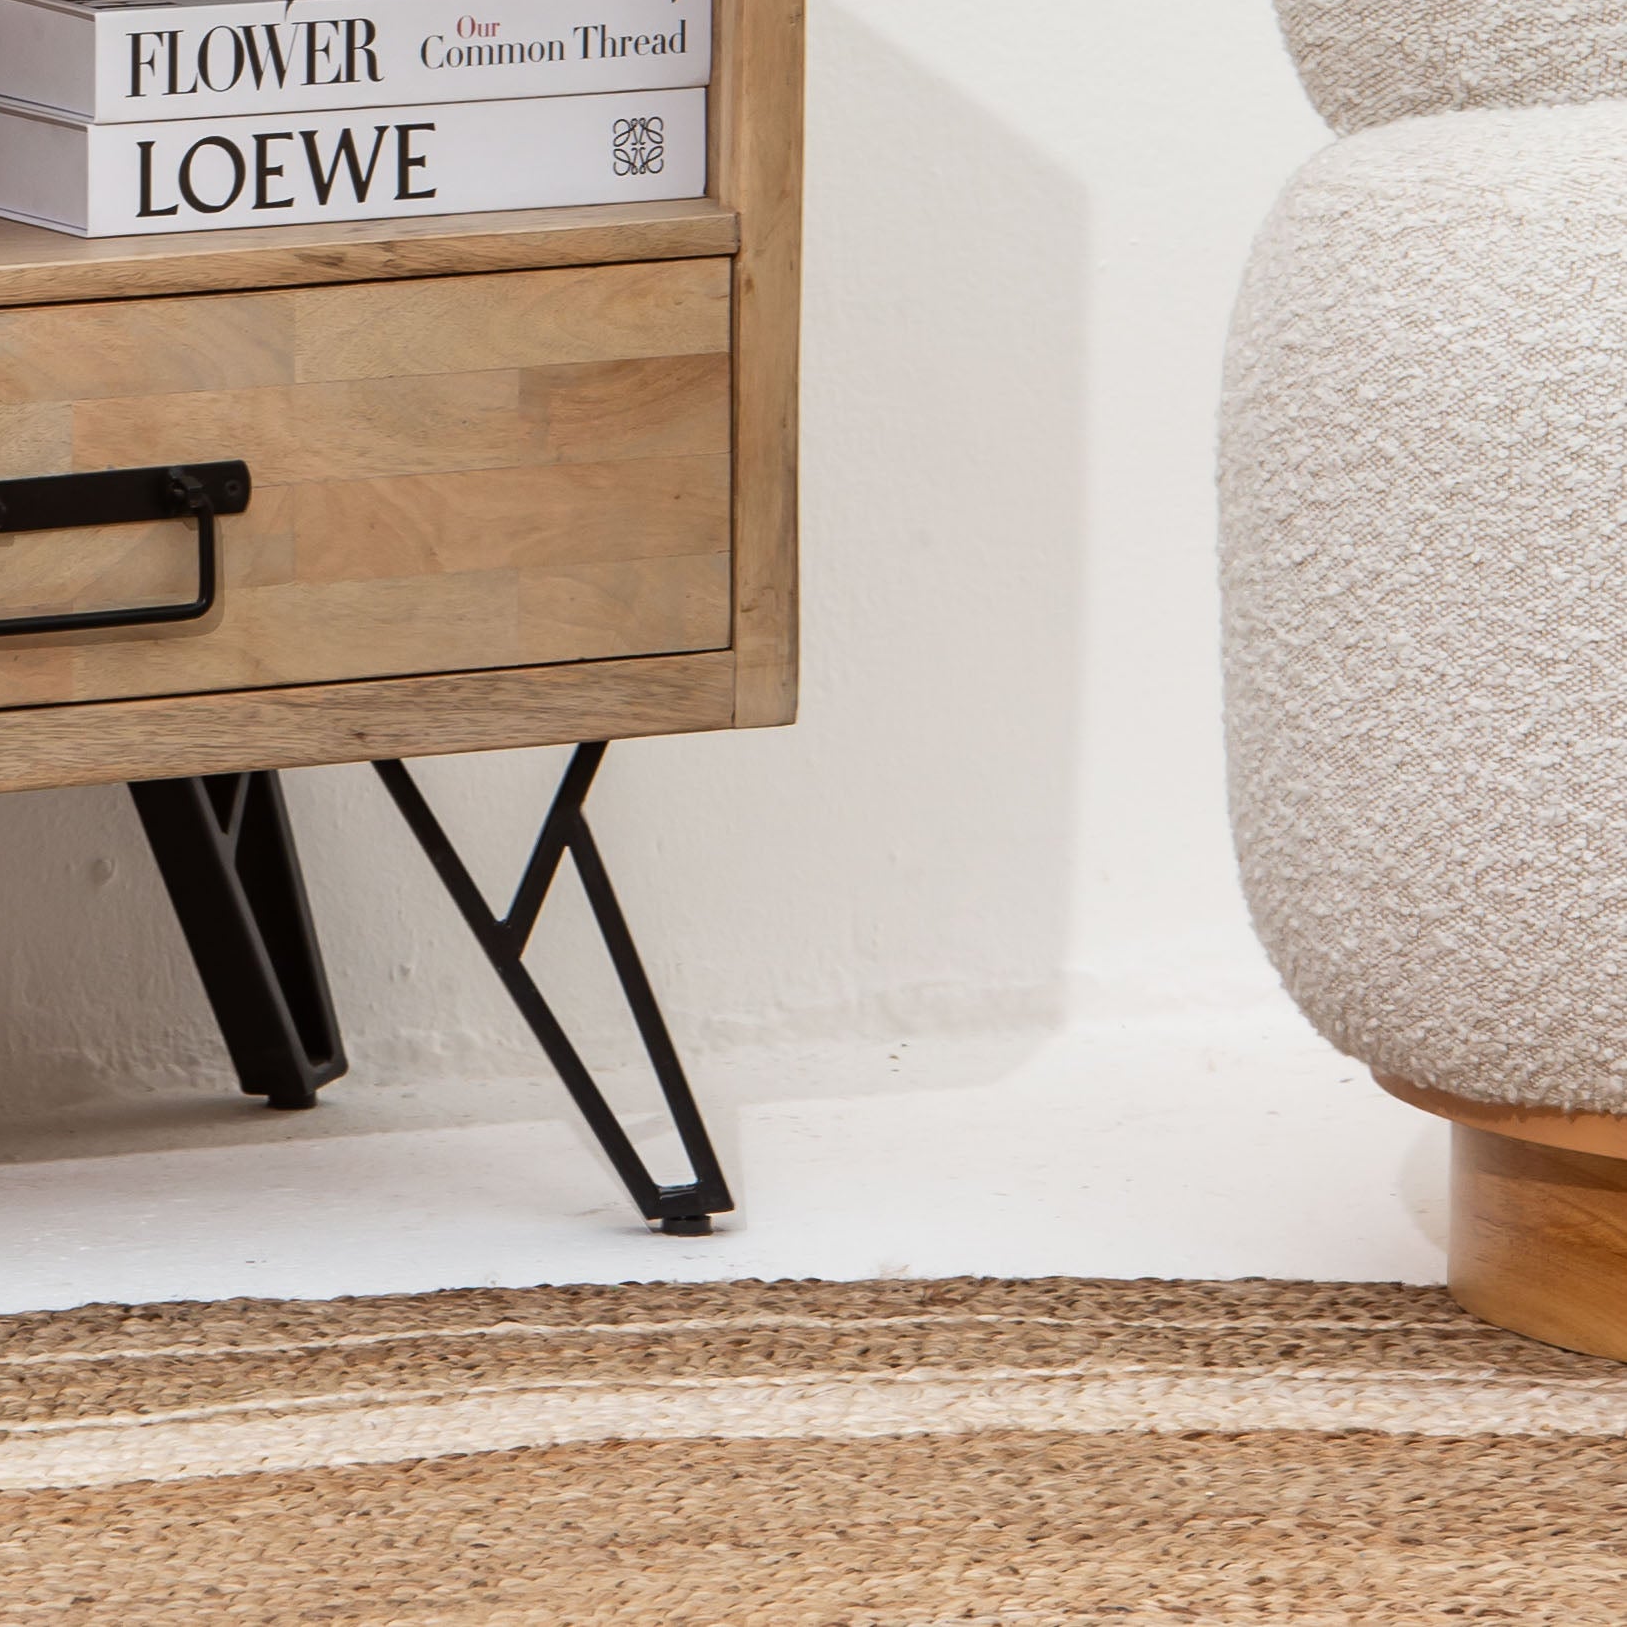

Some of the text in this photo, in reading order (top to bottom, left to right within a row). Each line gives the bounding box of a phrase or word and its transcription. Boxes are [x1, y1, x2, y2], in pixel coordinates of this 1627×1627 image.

[125, 17, 384, 98] FLOWER
[420, 19, 687, 70] Common Thread
[456, 15, 501, 39] Our
[135, 122, 437, 218] LOEWE
